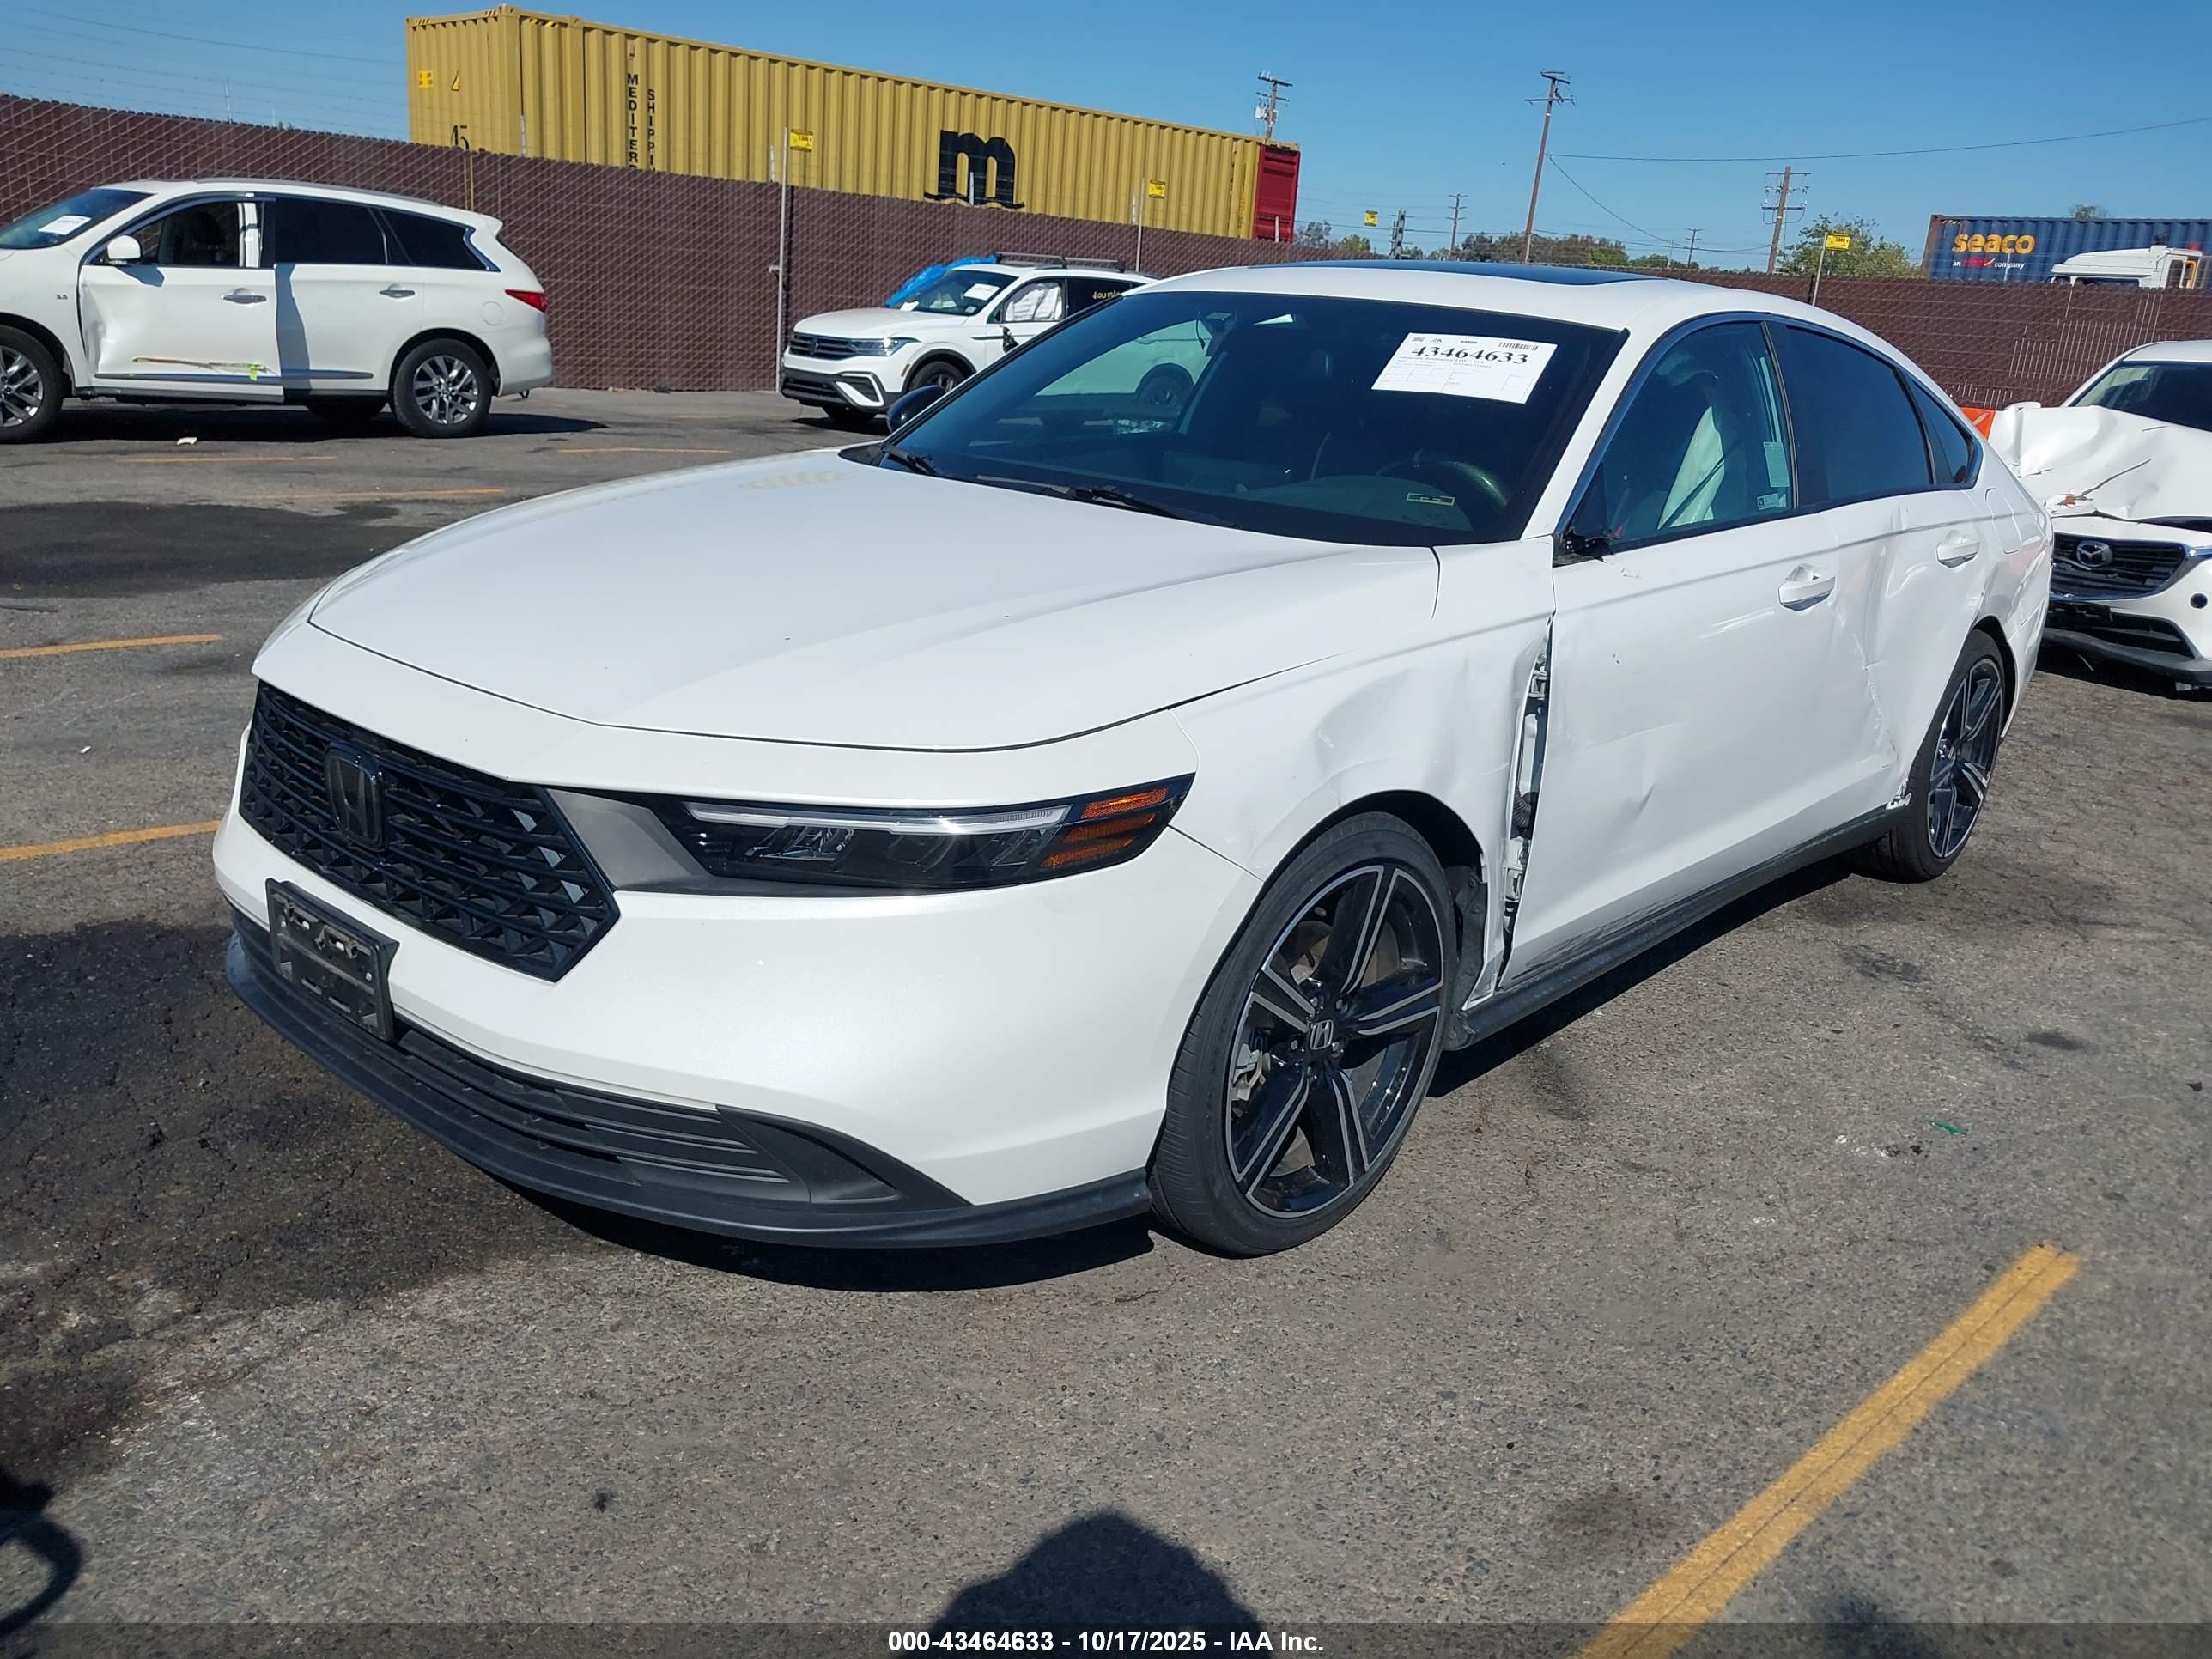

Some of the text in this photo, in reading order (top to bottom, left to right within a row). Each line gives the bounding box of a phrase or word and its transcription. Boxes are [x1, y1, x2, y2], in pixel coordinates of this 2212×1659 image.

[627, 73, 638, 168] MEDITER
[647, 89, 656, 171] SHIPPI
[1952, 234, 2035, 254] seaco
[1411, 345, 1528, 364] 43464633
